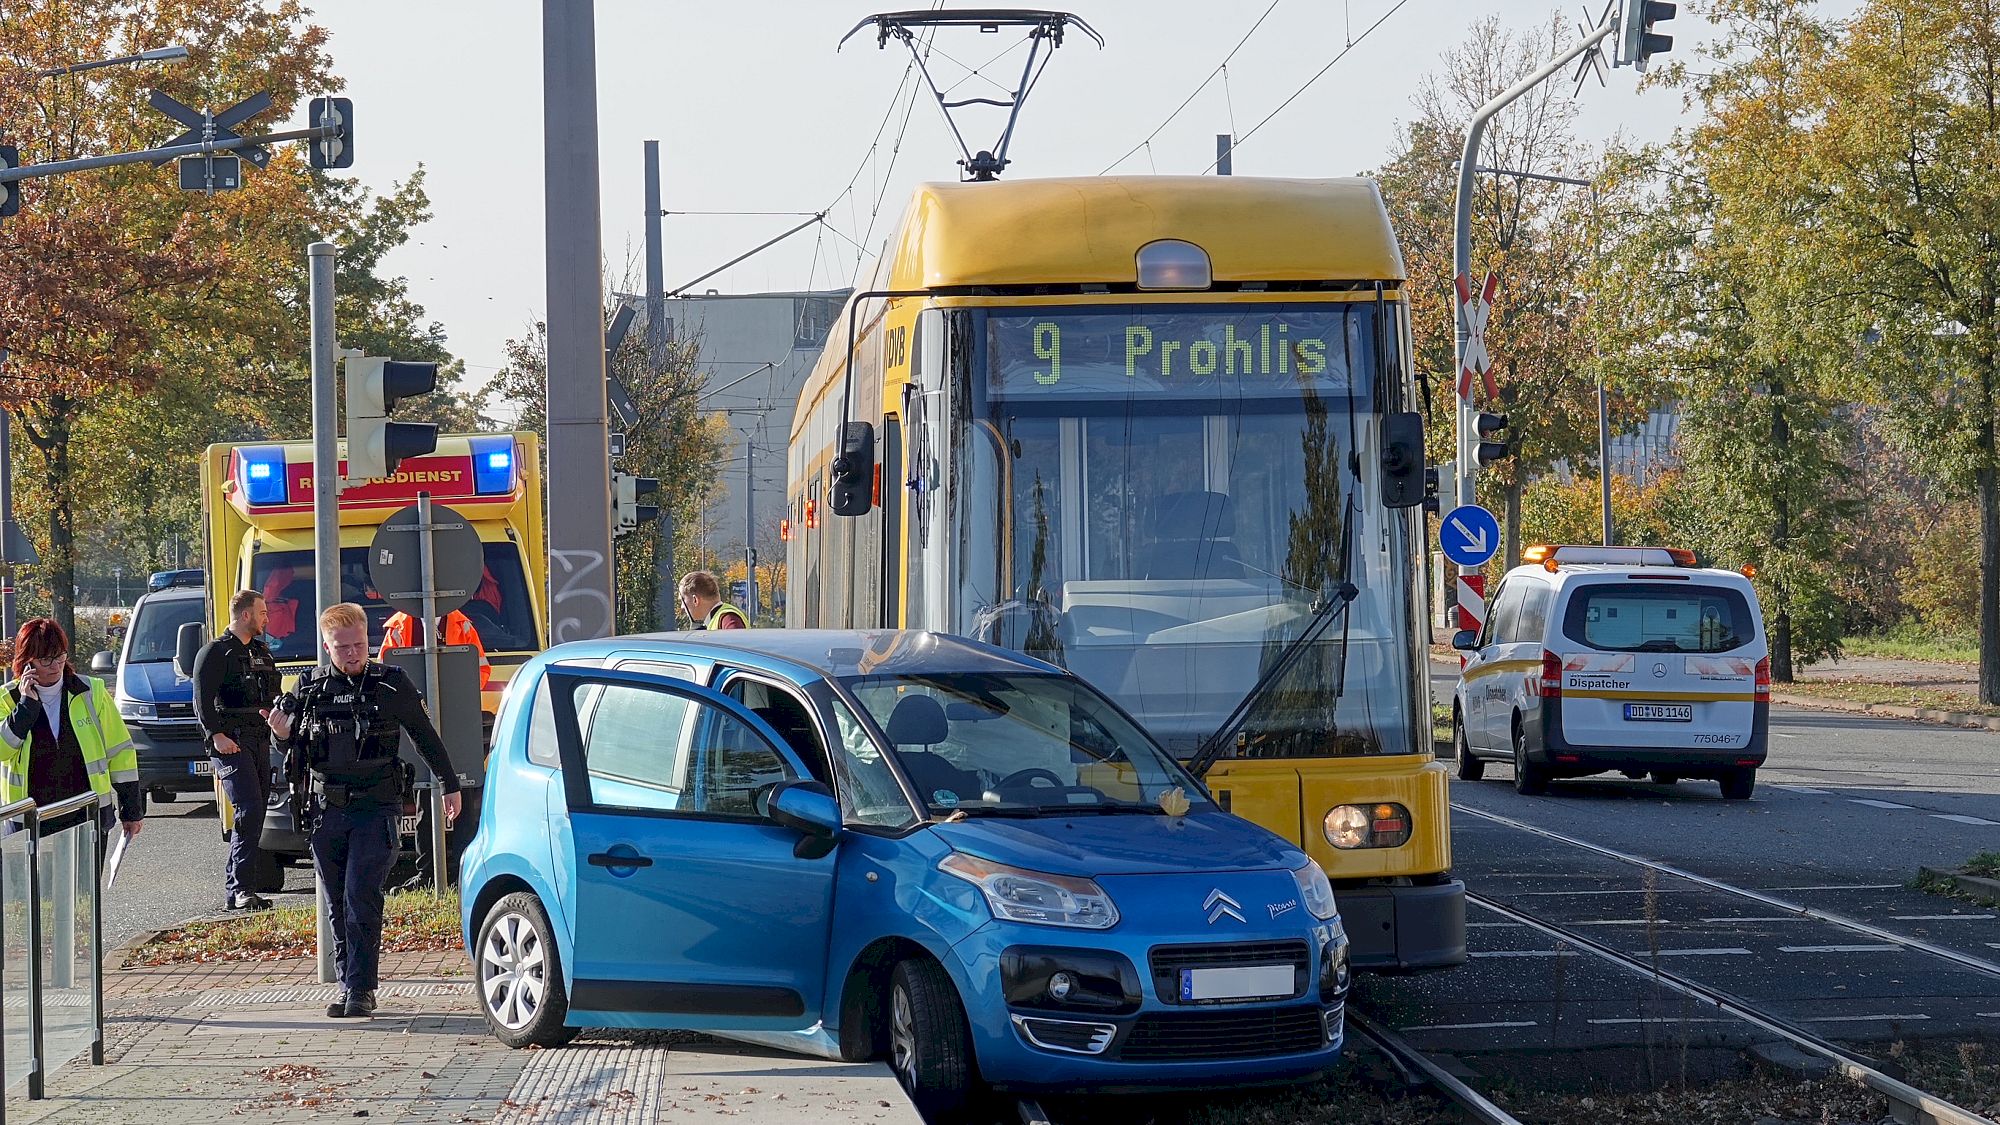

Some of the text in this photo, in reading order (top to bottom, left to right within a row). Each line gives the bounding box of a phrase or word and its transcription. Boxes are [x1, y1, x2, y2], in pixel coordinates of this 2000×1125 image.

[888, 326, 905, 368] DVB
[1033, 322, 1326, 385] 9 Prohlis
[1569, 678, 1631, 690] Dispatcher
[1631, 706, 1690, 718] DD VB 1146
[1693, 734, 1741, 744] 775046-7
[1267, 899, 1297, 920] Picasso
